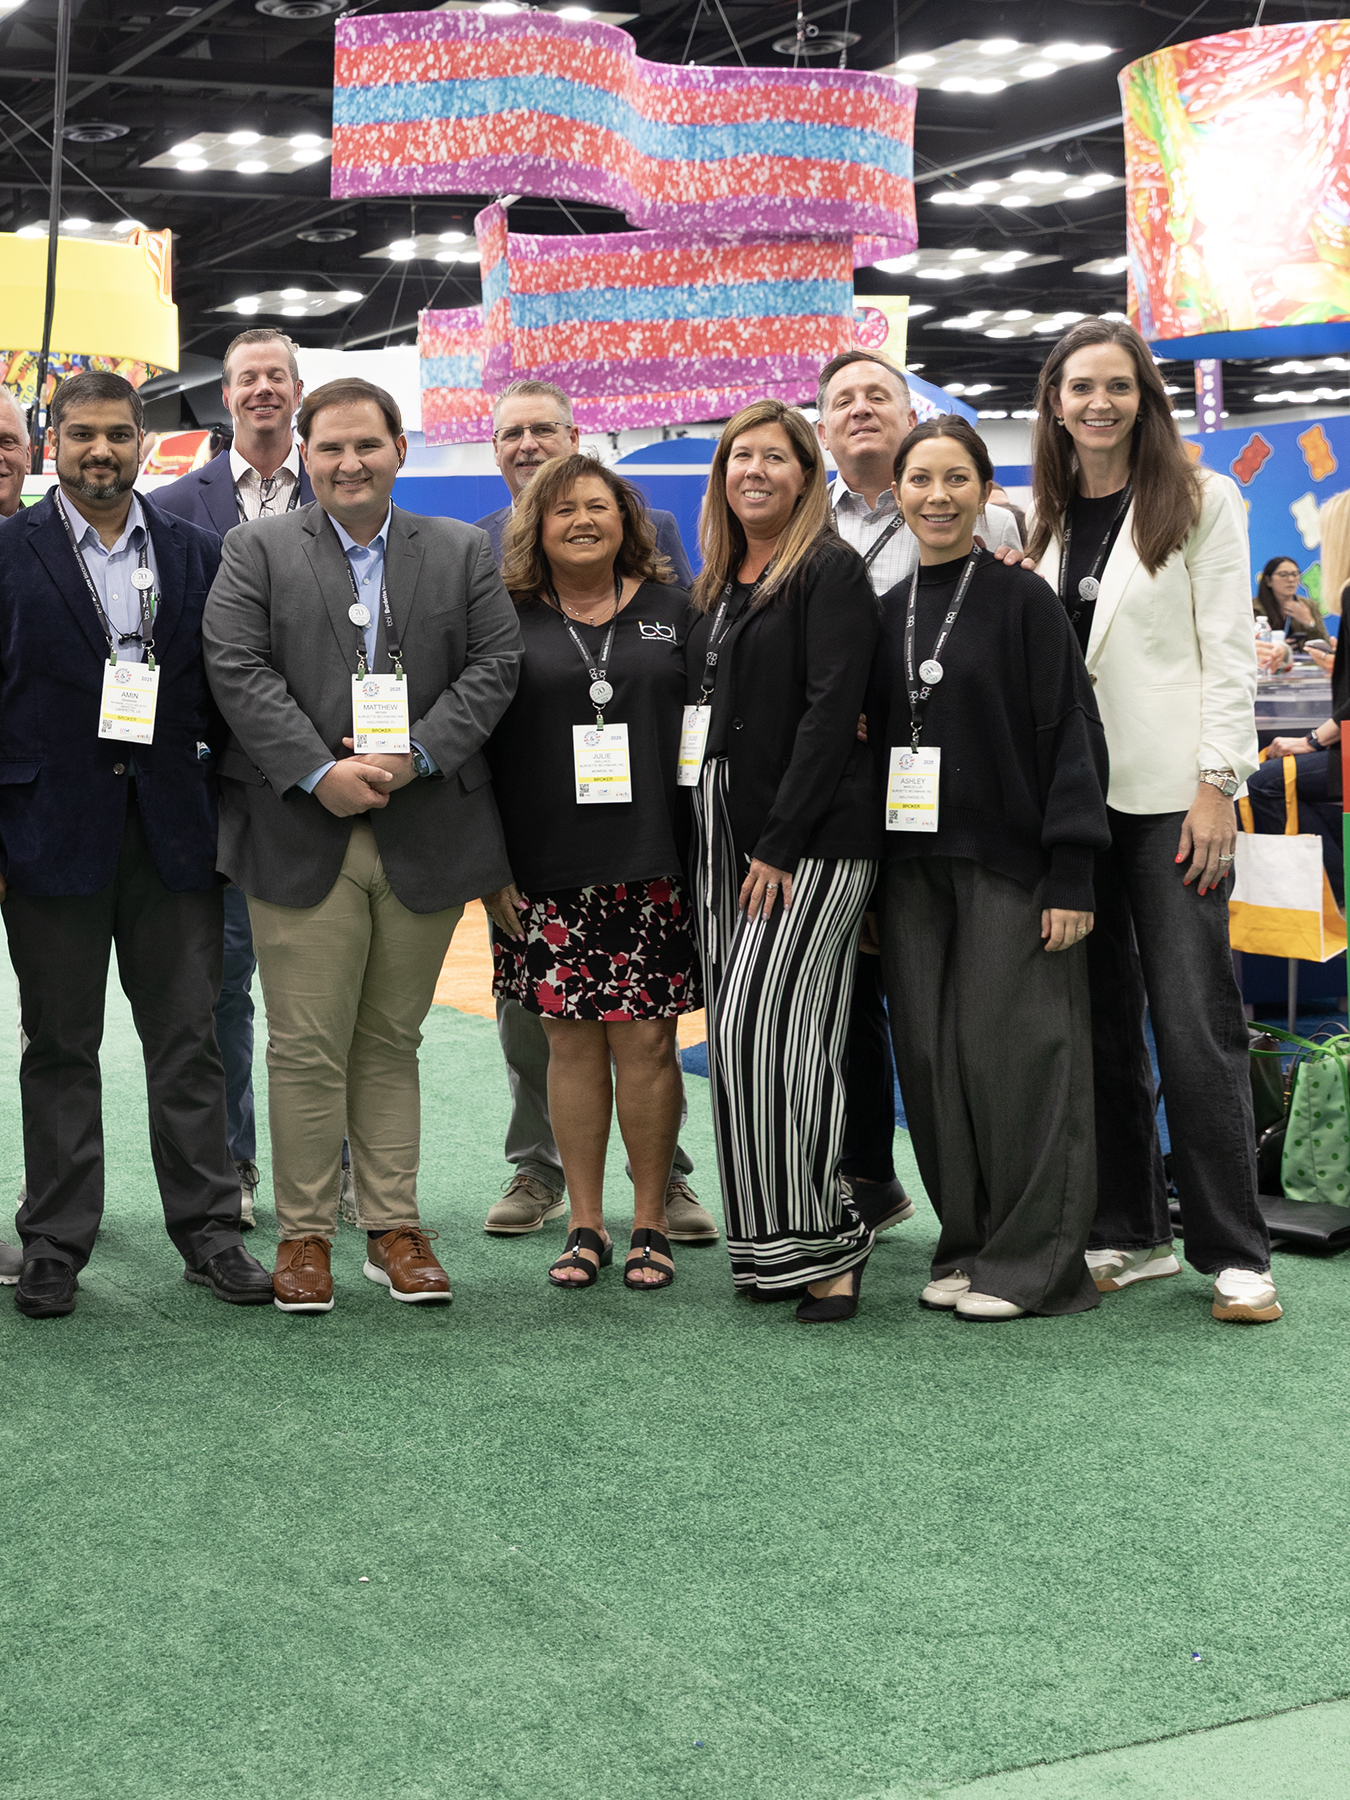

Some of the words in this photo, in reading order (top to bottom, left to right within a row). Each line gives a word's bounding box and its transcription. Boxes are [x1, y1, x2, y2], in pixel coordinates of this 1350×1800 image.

[1085, 582, 1093, 591] 70
[596, 686, 605, 694] 70
[121, 691, 139, 699] AMIN
